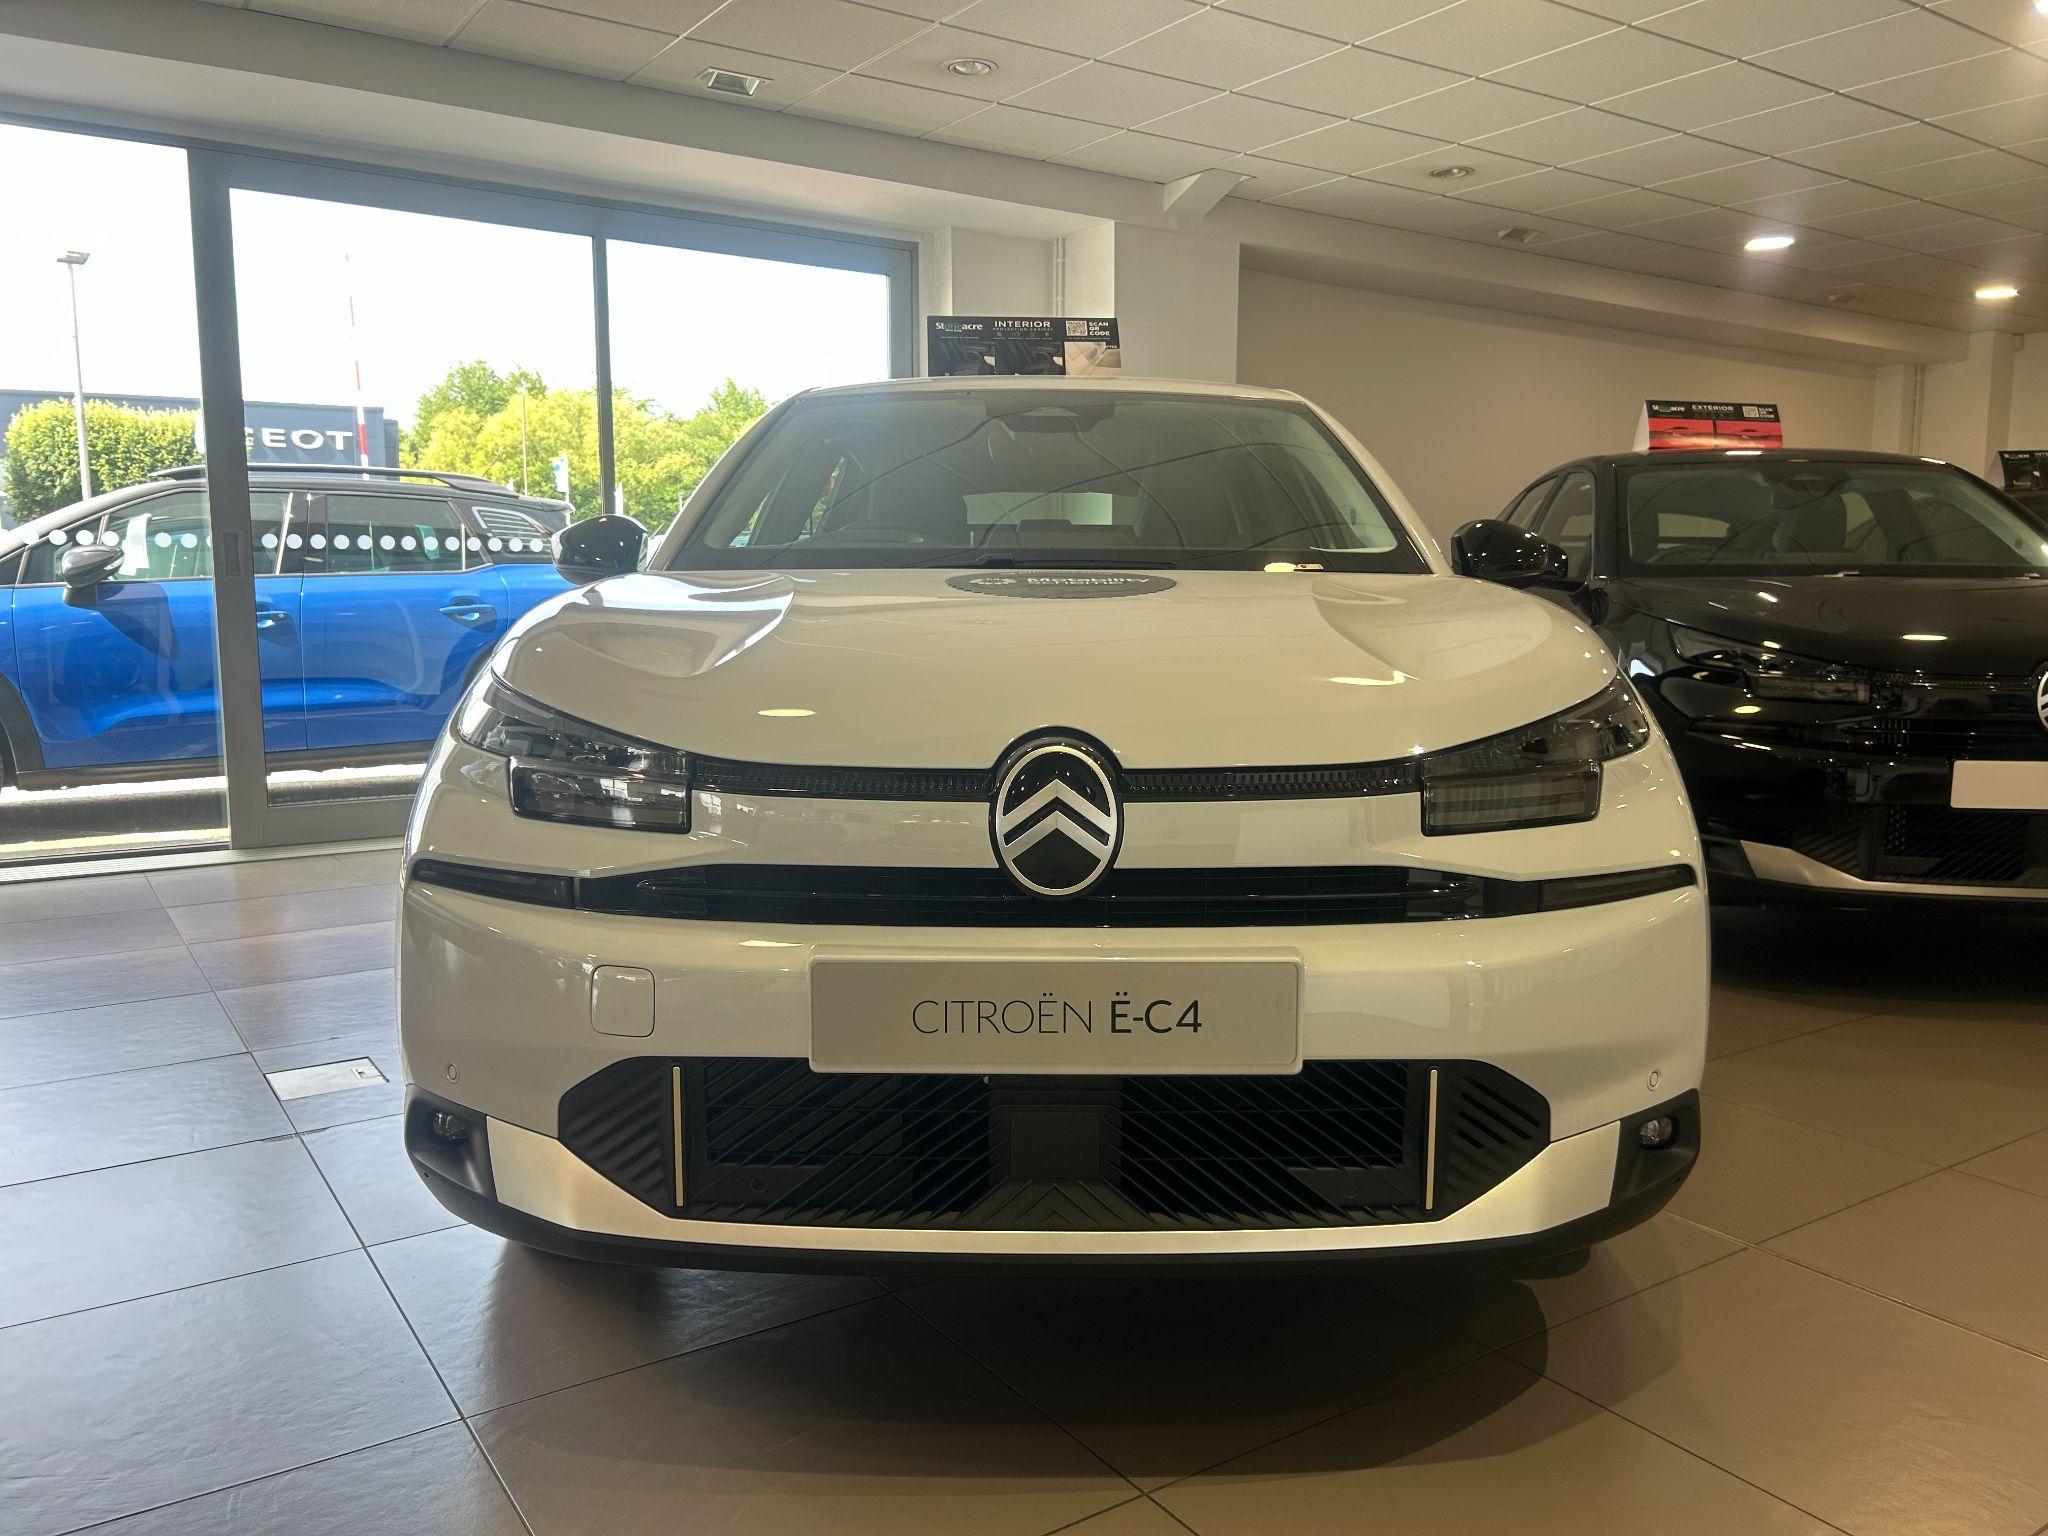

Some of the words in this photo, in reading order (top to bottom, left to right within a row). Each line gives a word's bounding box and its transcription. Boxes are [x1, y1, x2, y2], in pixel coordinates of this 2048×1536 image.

[994, 320, 1051, 328] INTERIOR
[911, 992, 1093, 1035] CITROËN
[1109, 991, 1203, 1034] Ë-C4
